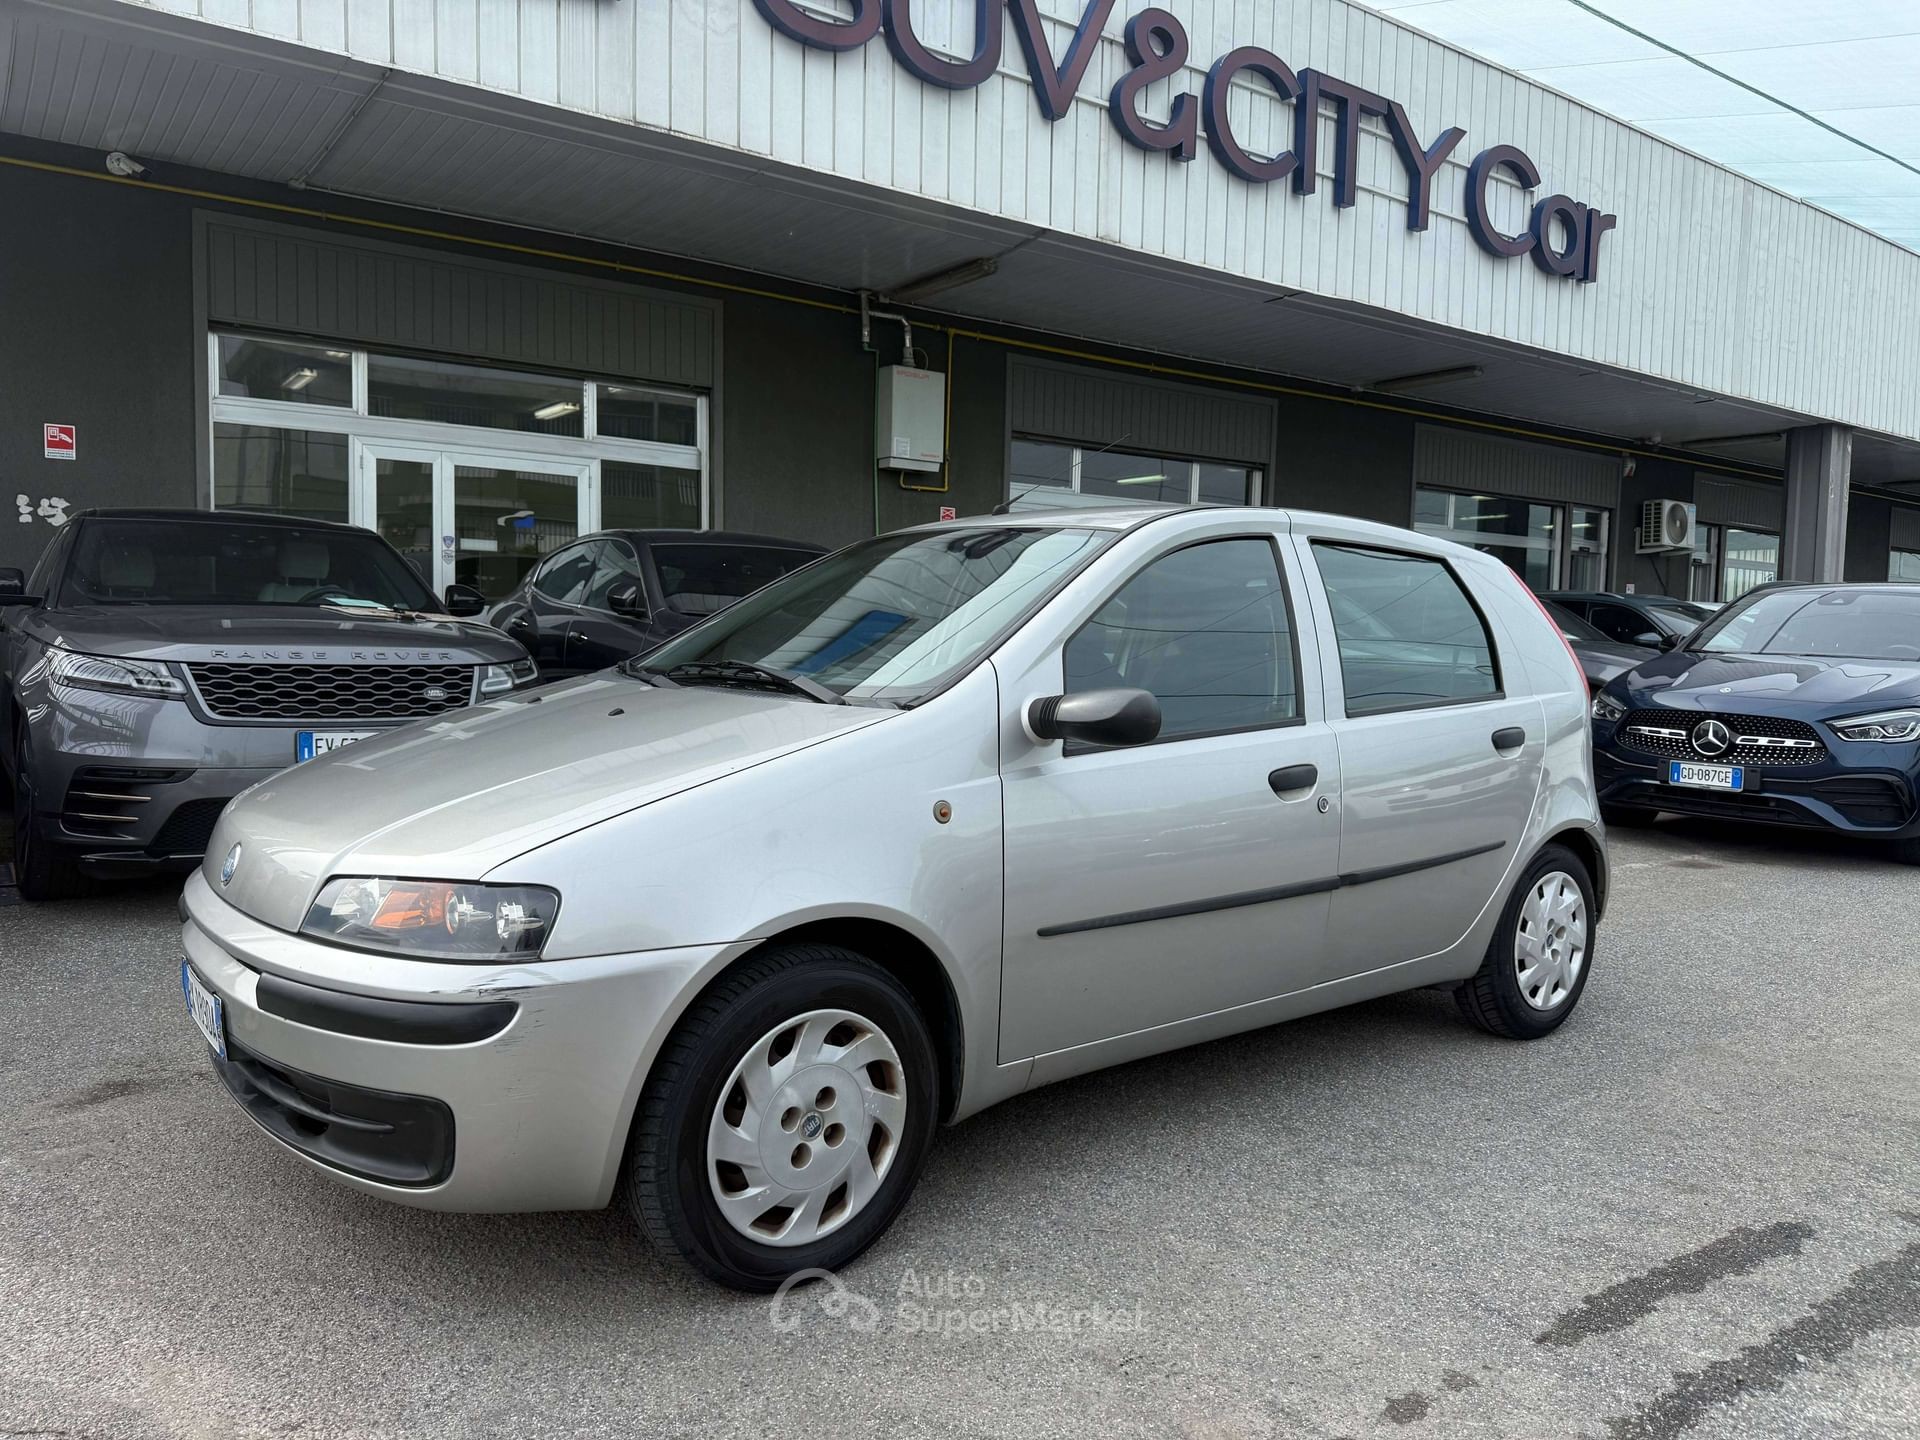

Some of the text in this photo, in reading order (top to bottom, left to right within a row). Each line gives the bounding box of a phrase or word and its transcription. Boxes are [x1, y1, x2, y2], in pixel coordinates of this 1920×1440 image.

[1465, 144, 1617, 284] Car
[211, 650, 453, 661] RANGE ROVER
